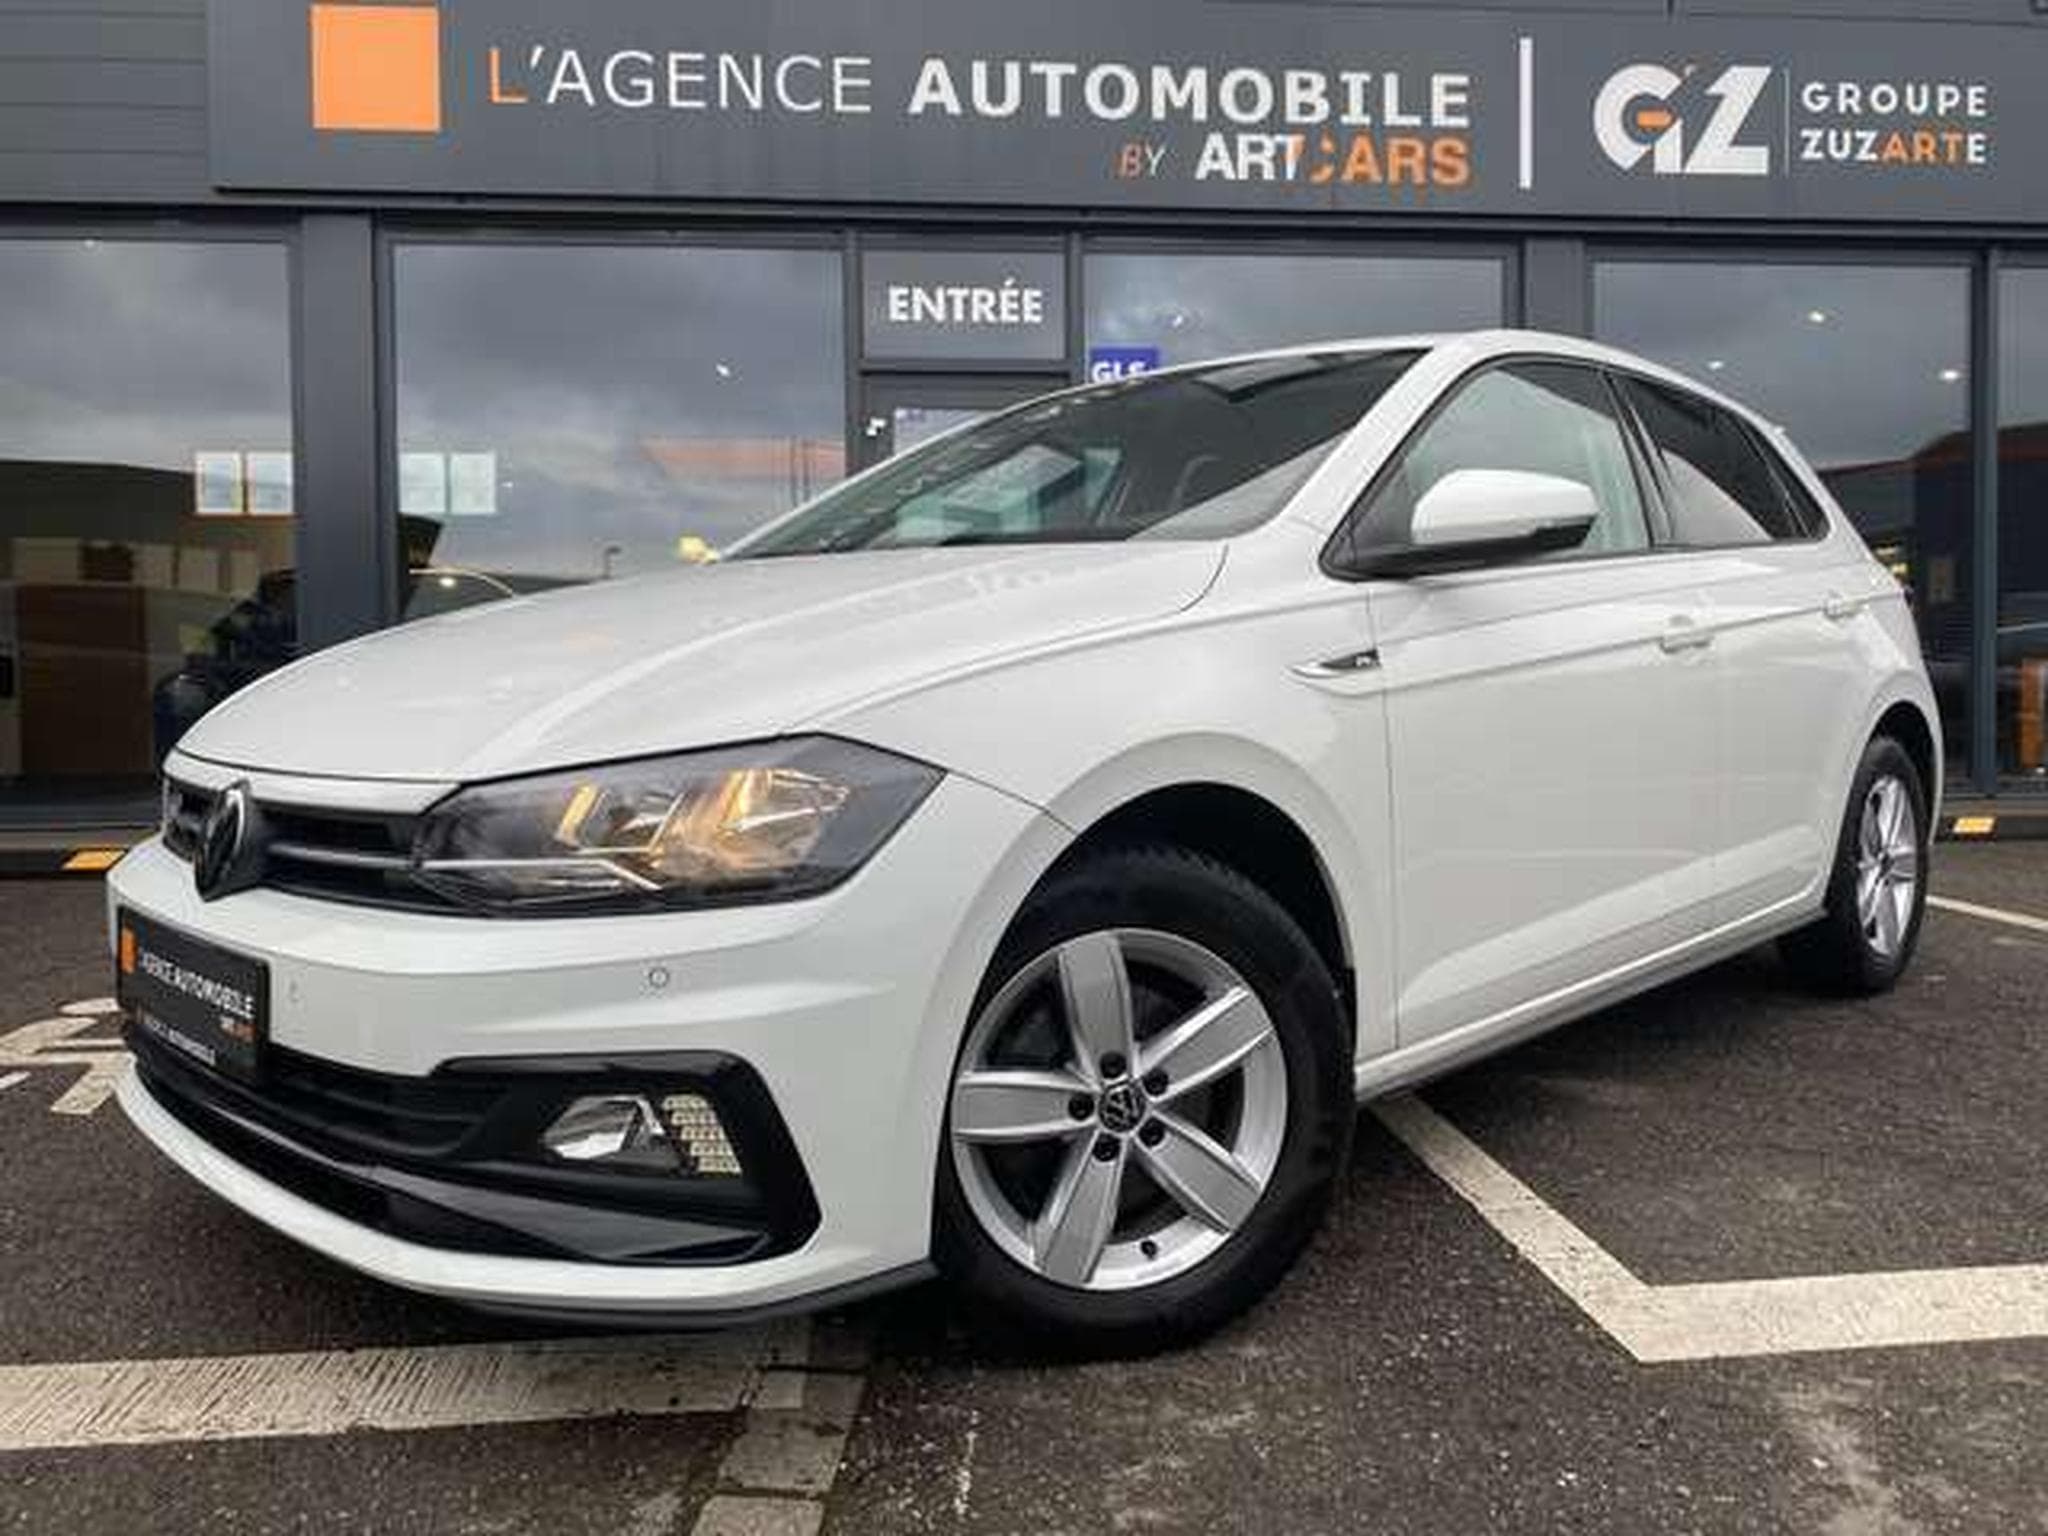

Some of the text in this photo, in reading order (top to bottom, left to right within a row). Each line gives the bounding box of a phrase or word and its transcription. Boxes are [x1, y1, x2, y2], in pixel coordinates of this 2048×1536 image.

[488, 46, 1471, 128] L'AGENCE AUTOMOBILE
[1801, 82, 1988, 117] GROUPE
[1119, 144, 1166, 177] BY
[1801, 129, 1987, 165] ZUZARTE
[888, 277, 1043, 324] ENTRÉE
